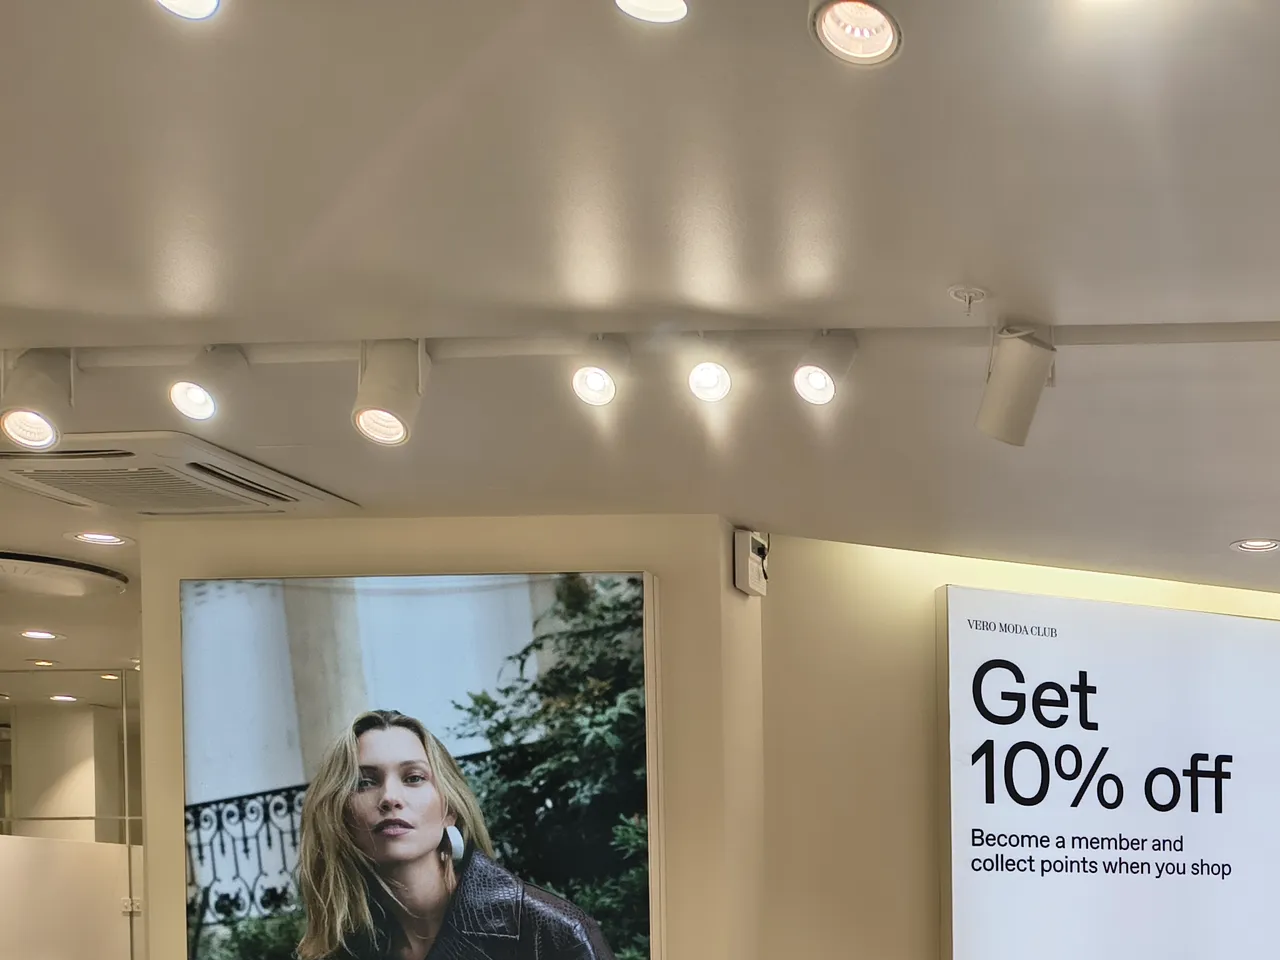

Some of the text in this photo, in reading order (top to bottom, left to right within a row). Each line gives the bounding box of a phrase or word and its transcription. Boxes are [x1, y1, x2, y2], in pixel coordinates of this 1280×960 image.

[967, 618, 1058, 638] VERO MODA CLUB
[972, 659, 1099, 731] Get
[971, 739, 1233, 814] 10% off
[971, 828, 1184, 852] Become a member and
[971, 854, 1232, 880] collect points when you shop
